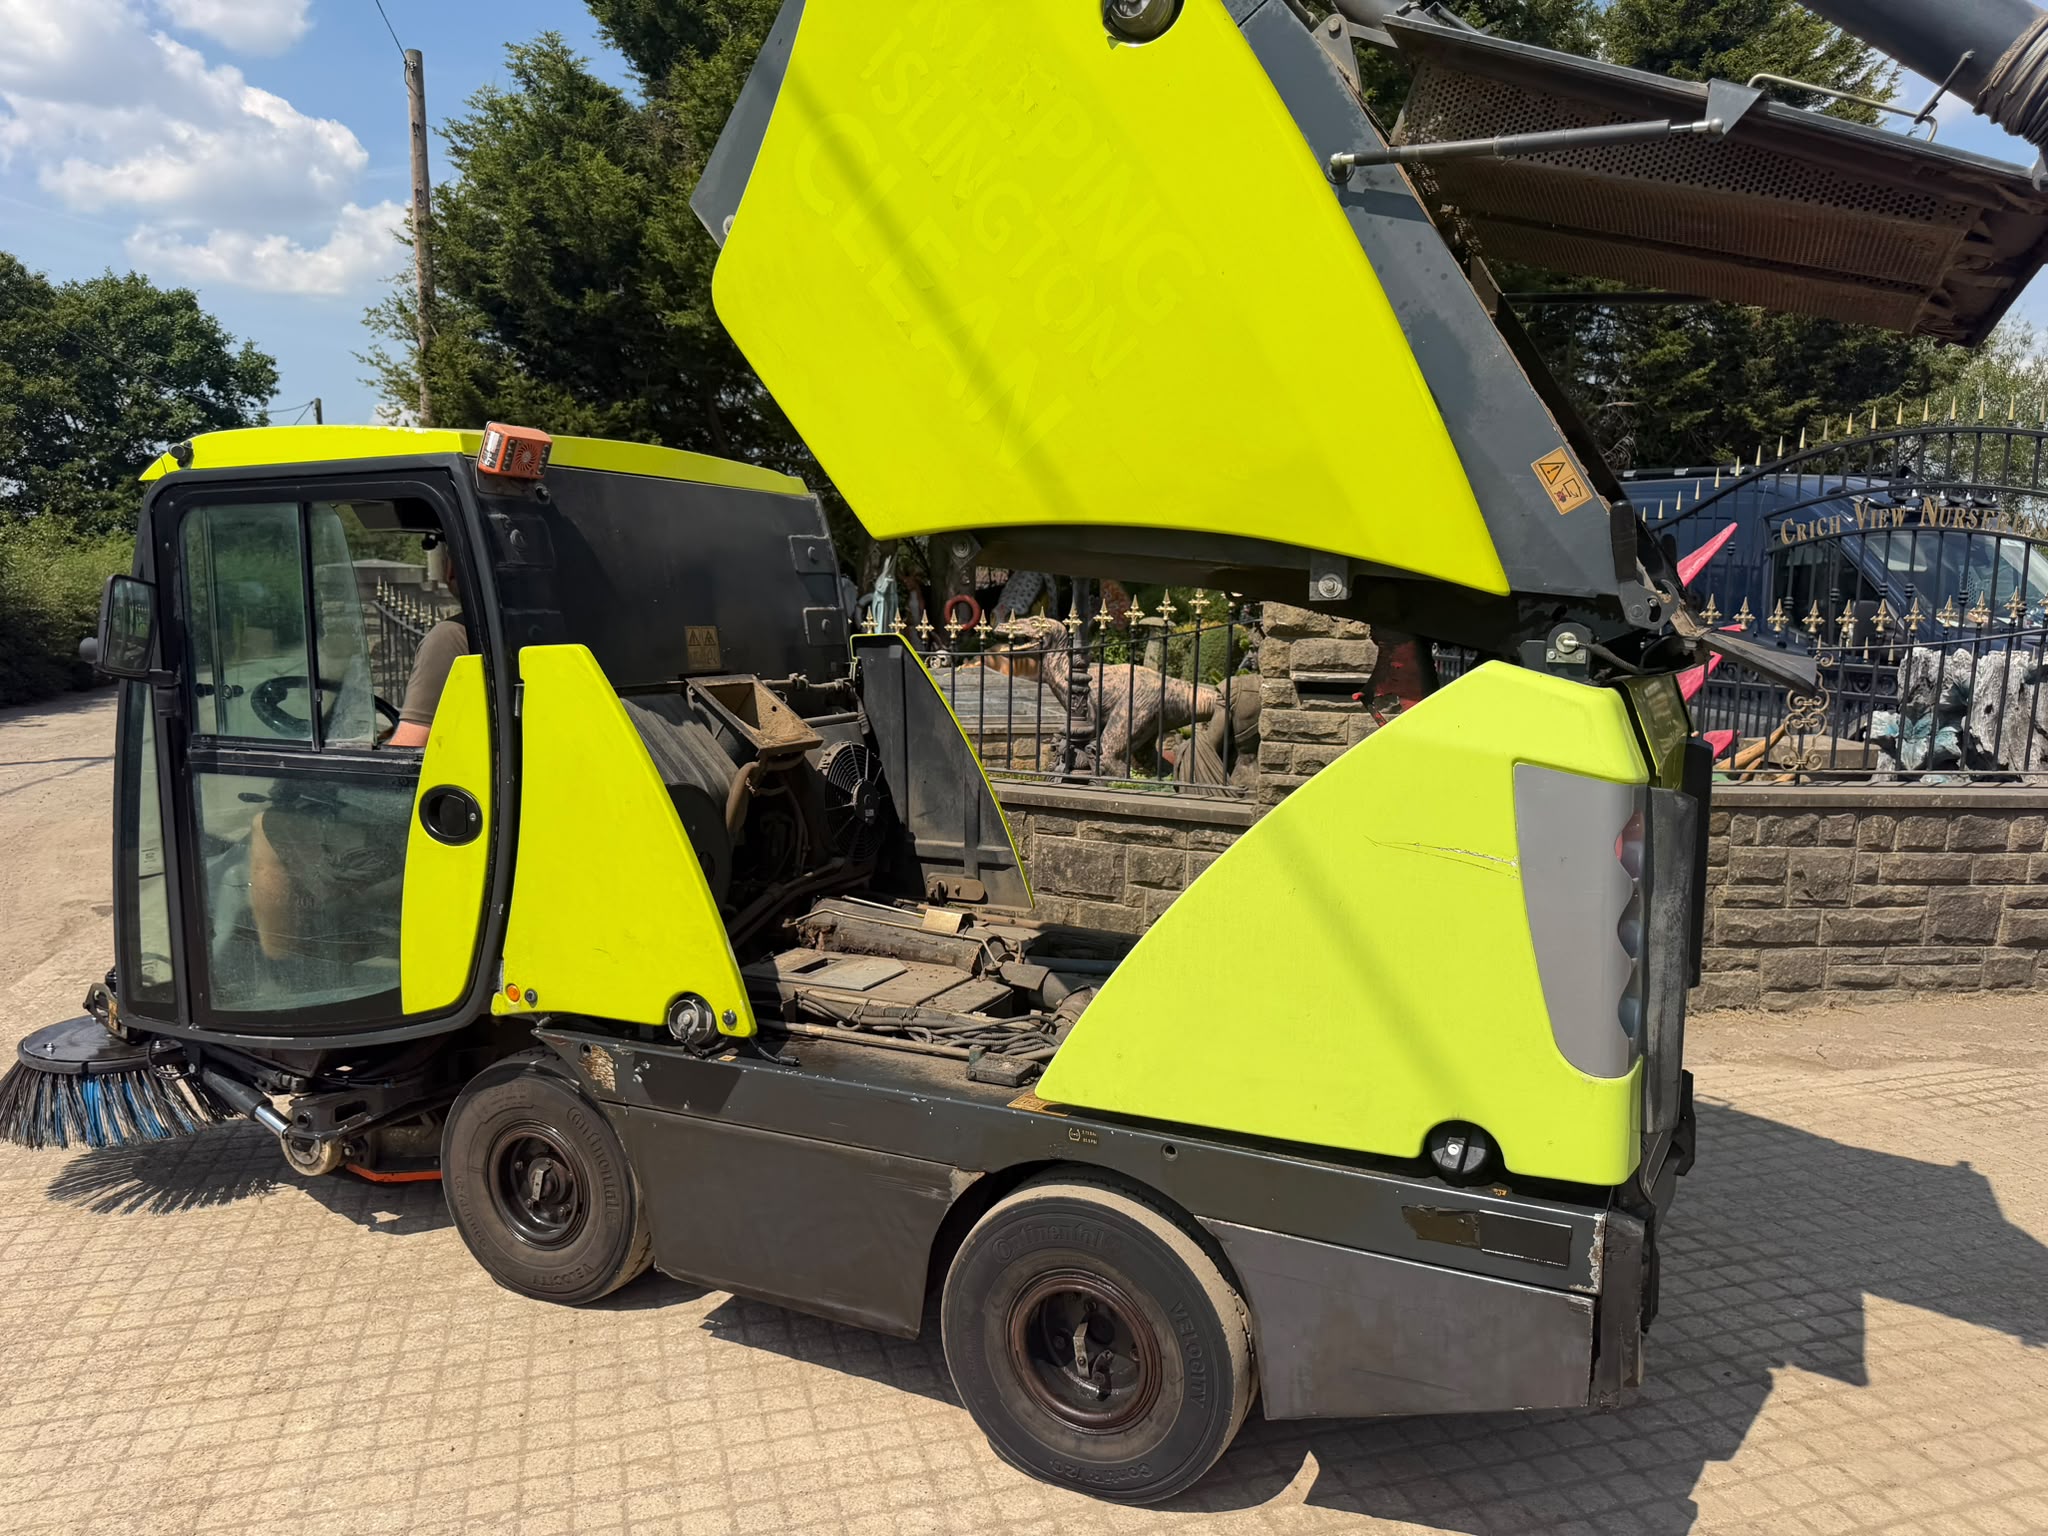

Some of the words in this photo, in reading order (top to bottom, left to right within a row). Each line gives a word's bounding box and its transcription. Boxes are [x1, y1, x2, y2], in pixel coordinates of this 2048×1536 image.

[794, 112, 1073, 470] CLEAN
[859, 28, 1139, 384] ISLINGTON
[1780, 514, 1841, 545] CRICH
[1853, 502, 1907, 530] VIEW
[1170, 1301, 1208, 1410] VELOCITY
